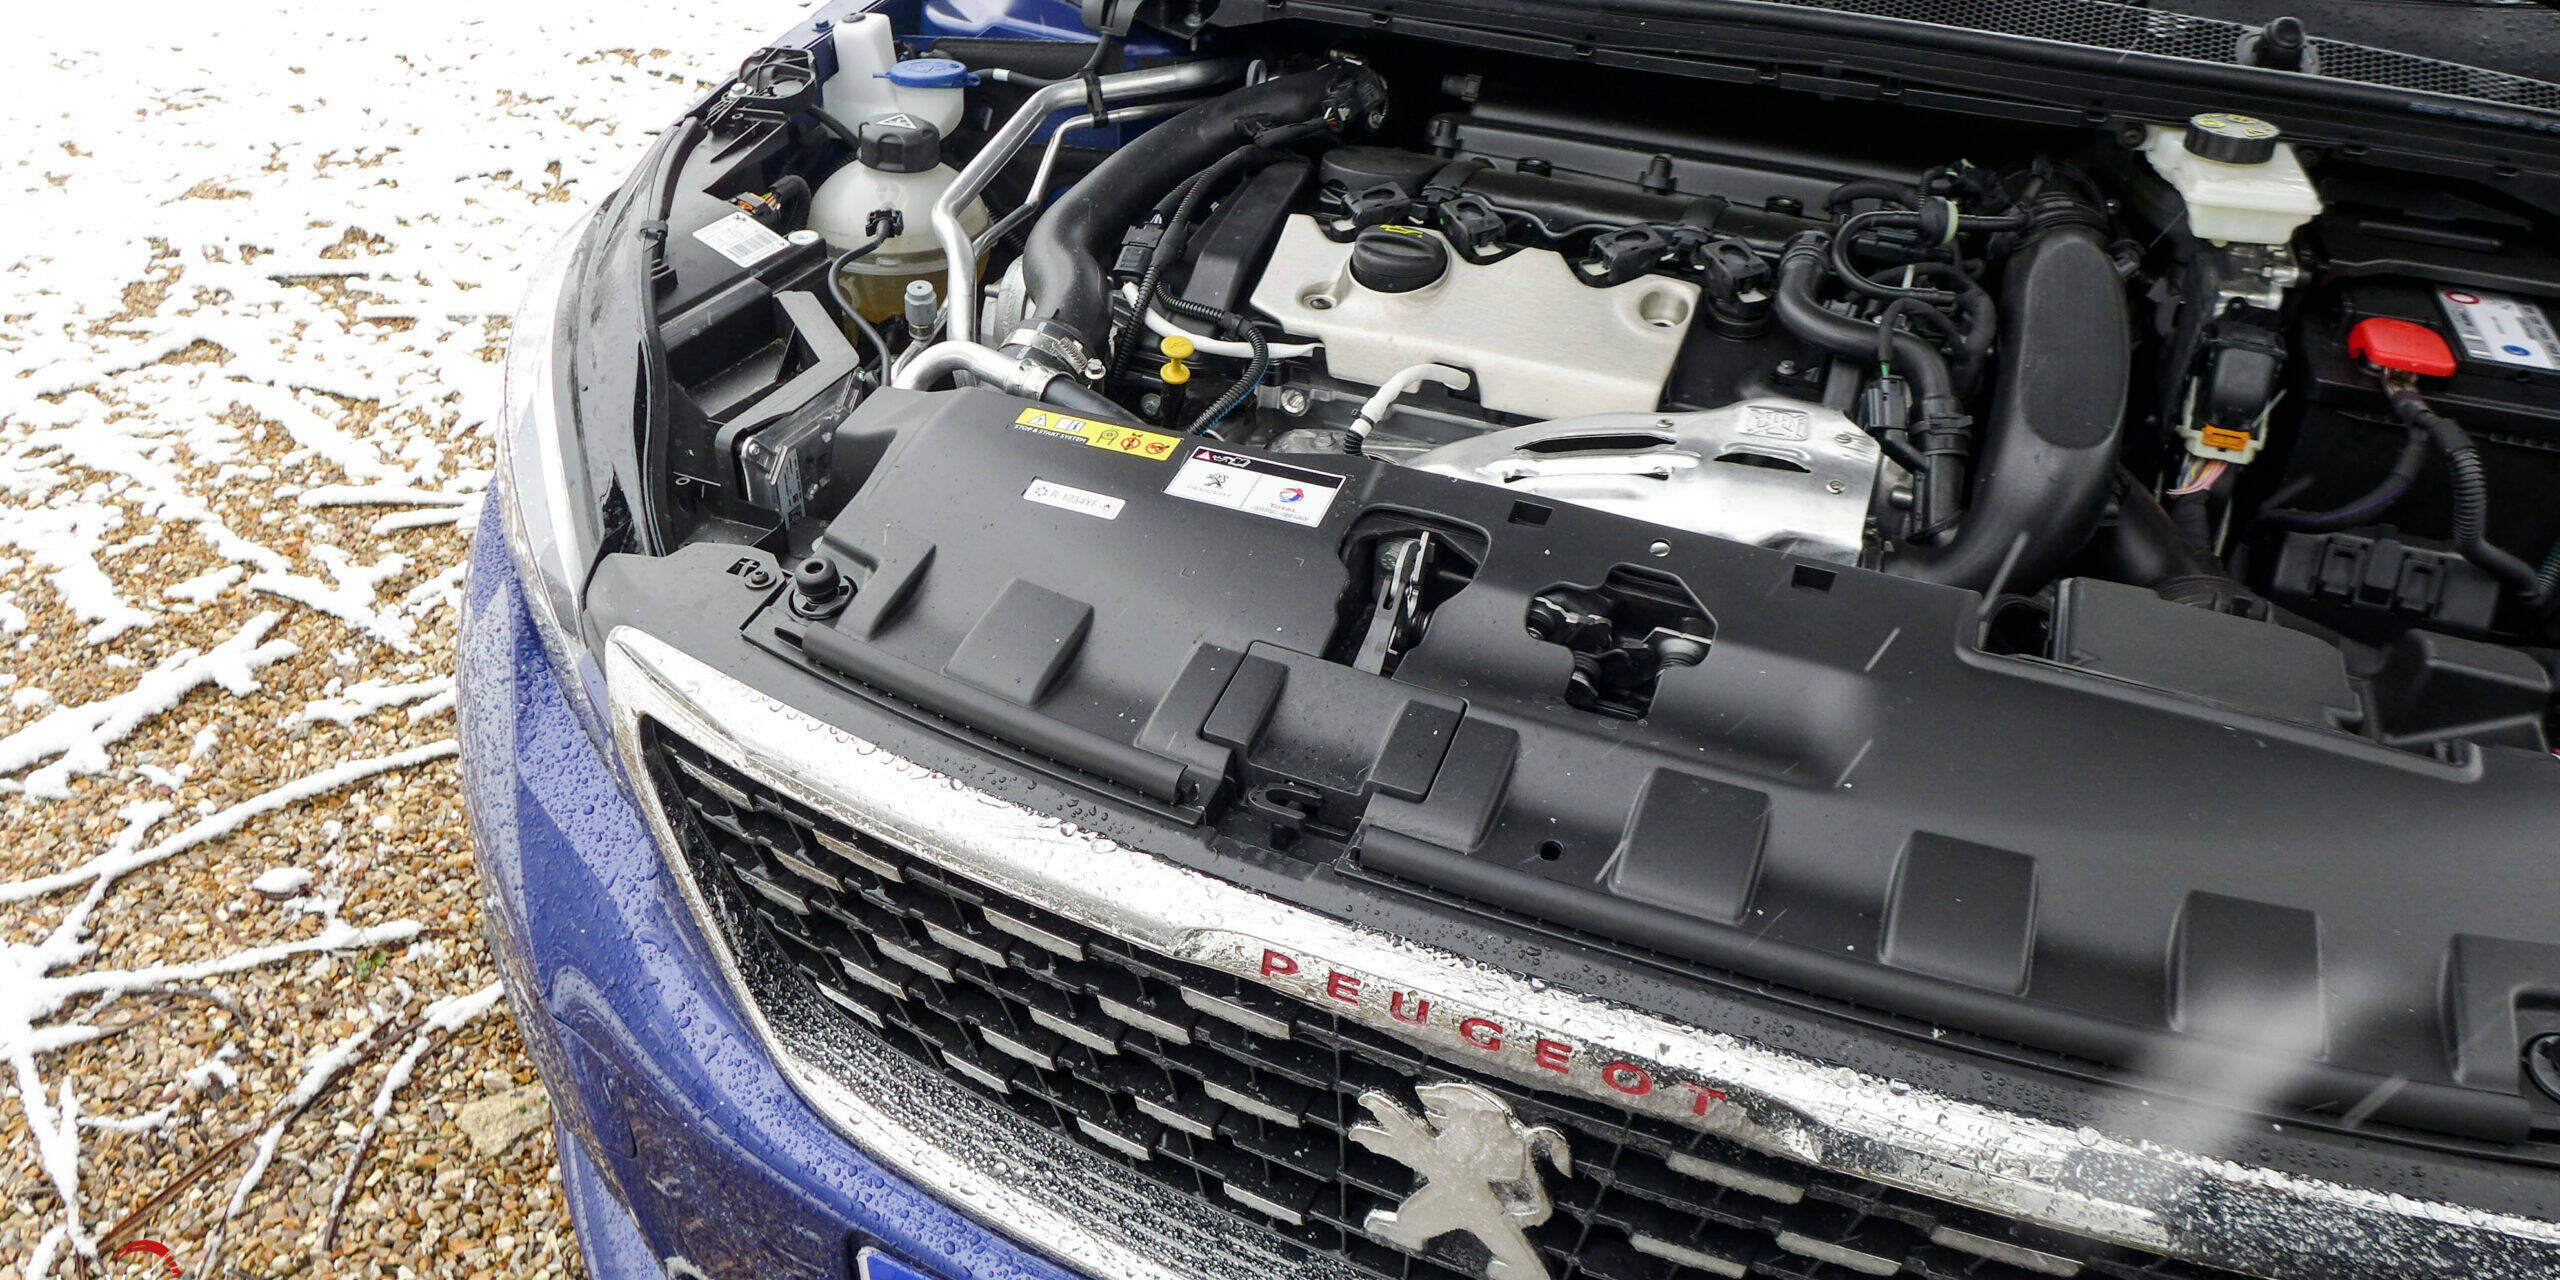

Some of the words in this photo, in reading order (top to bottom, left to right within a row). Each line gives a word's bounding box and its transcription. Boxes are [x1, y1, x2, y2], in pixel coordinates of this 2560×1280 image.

[1014, 424, 1033, 433] STOP
[1038, 429, 1060, 438] START
[1059, 433, 1087, 444] SYSTEM
[1186, 484, 1233, 498] PEUGEOT
[1269, 502, 1298, 514] TOTAL
[1260, 947, 1728, 1117] PEUGEOT
